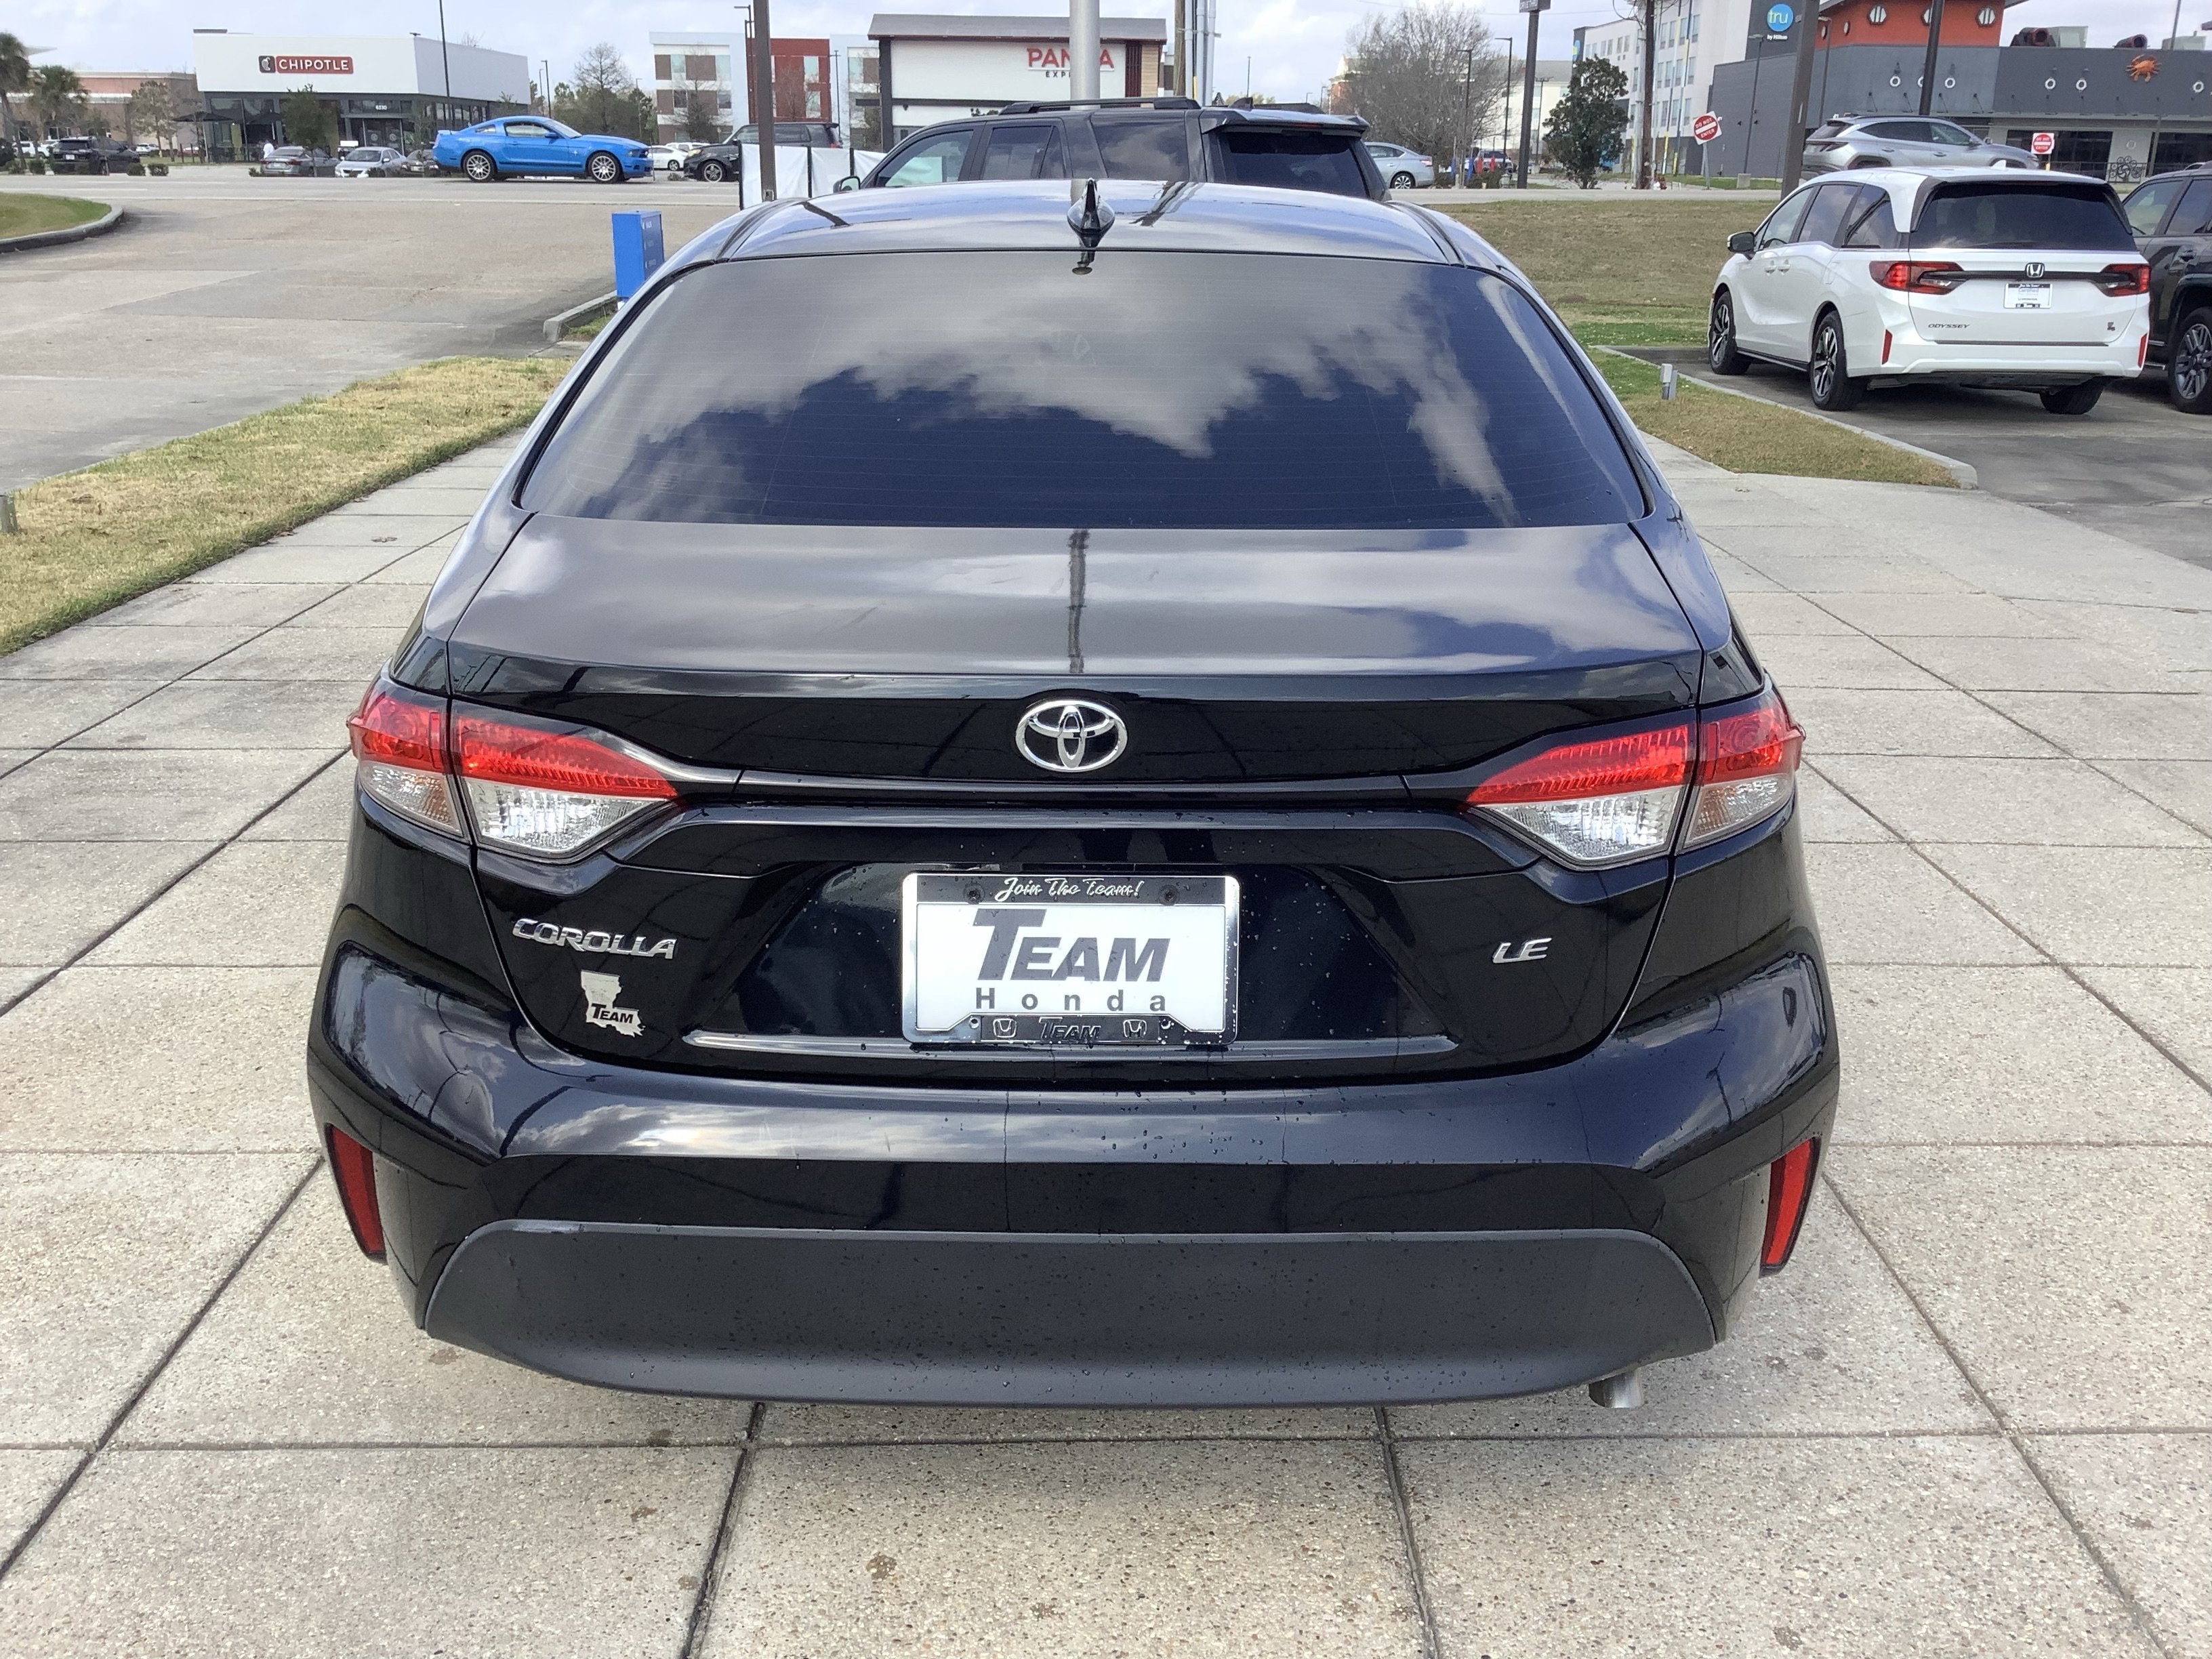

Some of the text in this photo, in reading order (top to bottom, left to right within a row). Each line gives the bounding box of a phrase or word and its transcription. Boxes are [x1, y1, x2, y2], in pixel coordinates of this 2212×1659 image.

[1768, 9, 1789, 24] tru
[279, 59, 350, 70] CHIPOTLE
[1027, 47, 1115, 68] PANA
[1702, 117, 1713, 125] NOT
[1700, 128, 1715, 138] ENTER
[994, 877, 1145, 902] Join The Team!
[512, 918, 677, 960] COROLLA
[972, 908, 1171, 982] TEAM
[1492, 937, 1553, 964] LE
[976, 987, 1166, 1012] Honda
[590, 1003, 634, 1024] TEAM
[1039, 1017, 1101, 1040] TEAM
